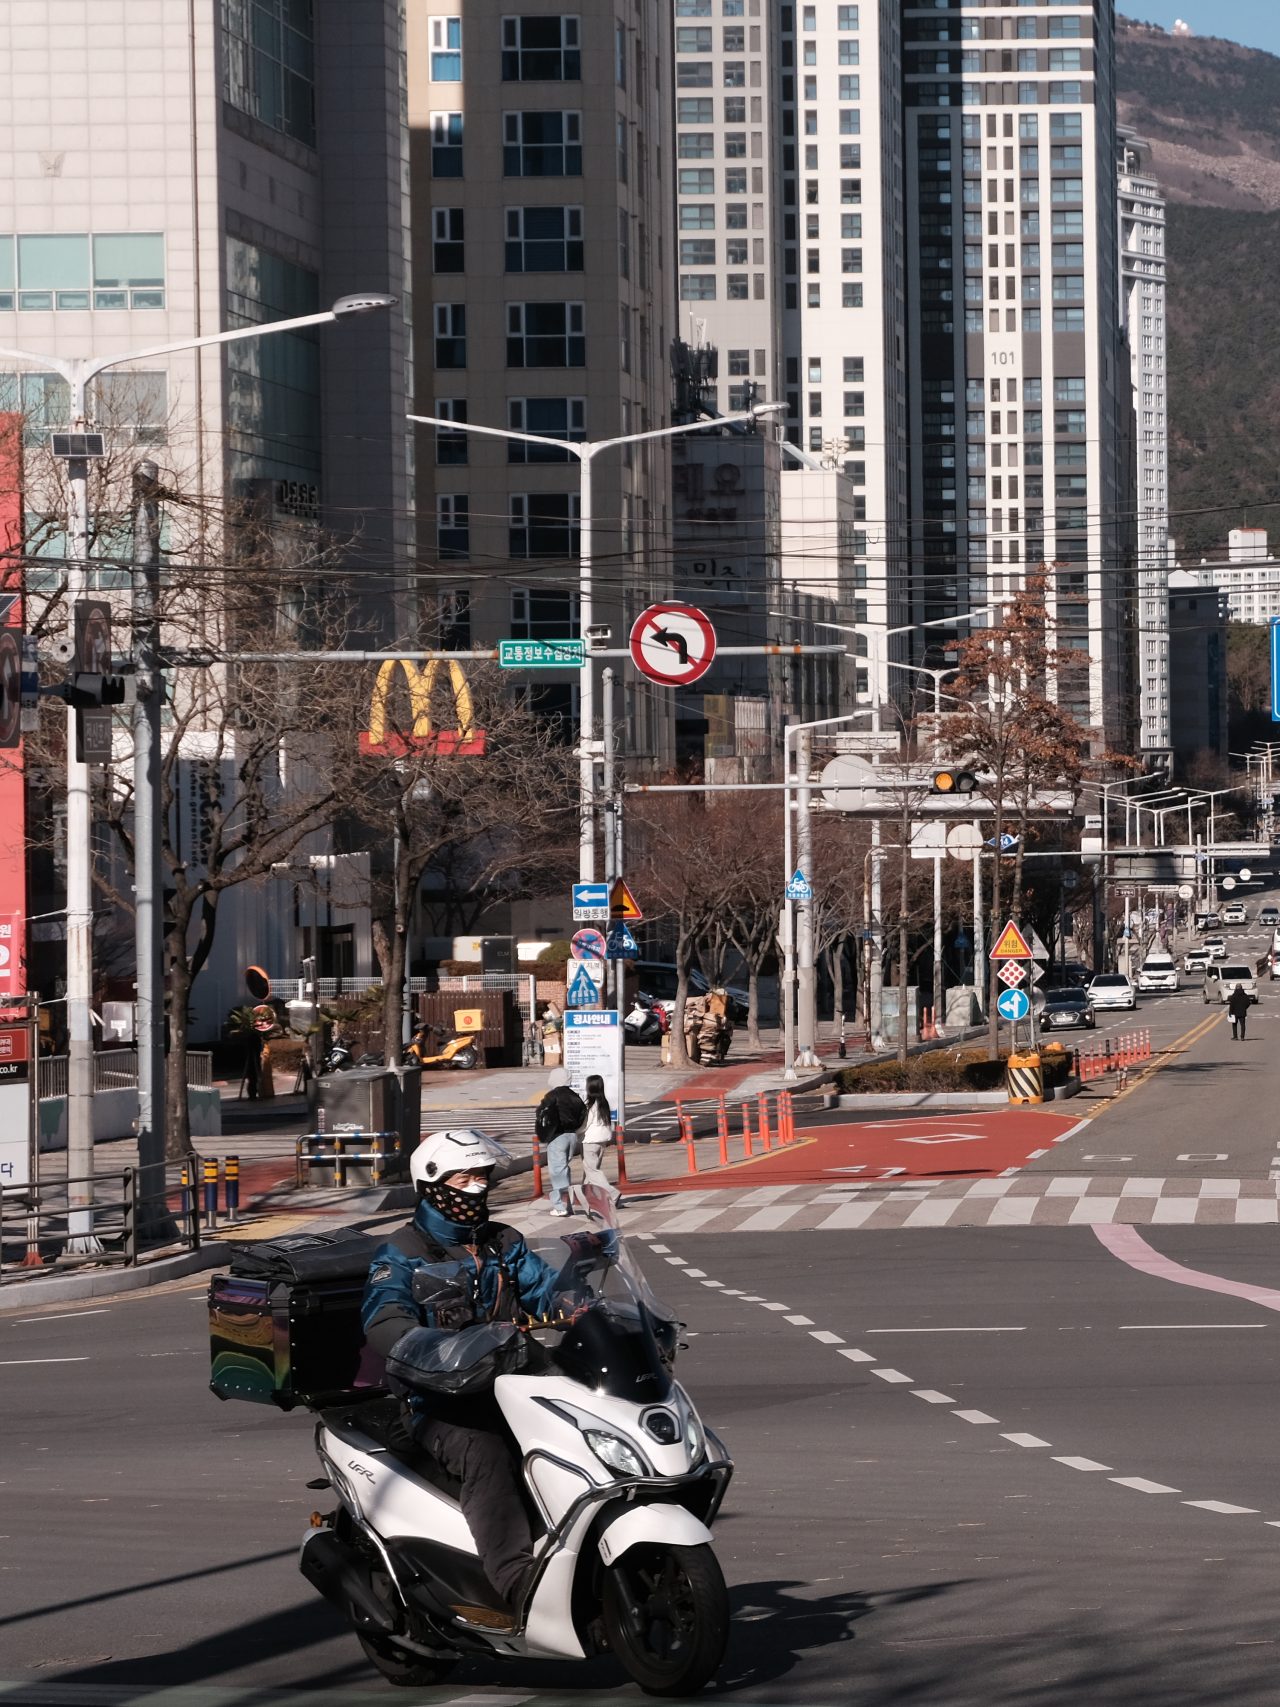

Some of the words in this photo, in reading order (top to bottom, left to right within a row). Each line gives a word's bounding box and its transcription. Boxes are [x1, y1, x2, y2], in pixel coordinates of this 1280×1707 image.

[991, 351, 1014, 365] 101
[504, 645, 581, 661] 교통정보수집장치
[574, 907, 608, 919] 일방통행
[1003, 939, 1018, 949] 위험
[572, 1013, 611, 1025] 공사안내
